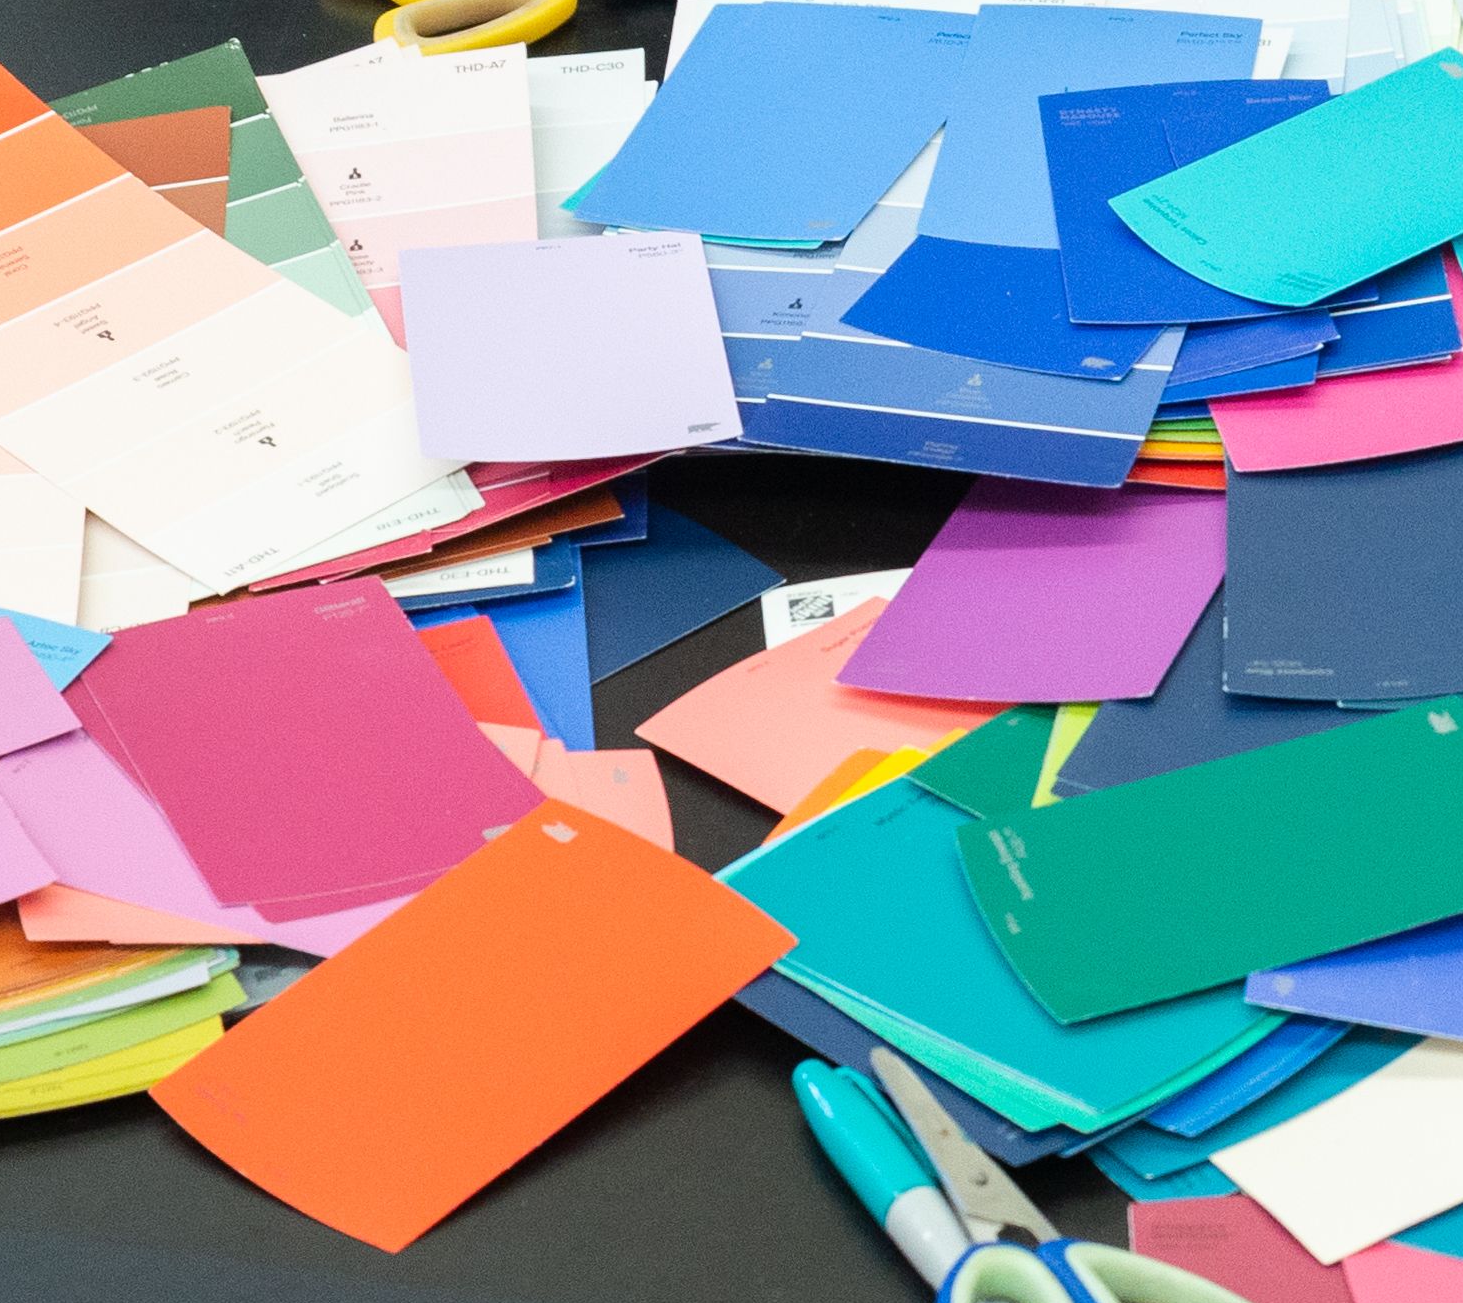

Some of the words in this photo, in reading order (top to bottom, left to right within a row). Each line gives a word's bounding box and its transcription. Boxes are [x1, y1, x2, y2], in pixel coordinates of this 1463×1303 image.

[1180, 31, 1218, 39] Perfect
[455, 59, 507, 74] THD-A7
[560, 61, 624, 75] THD-C30
[224, 547, 279, 577] THD-A11
